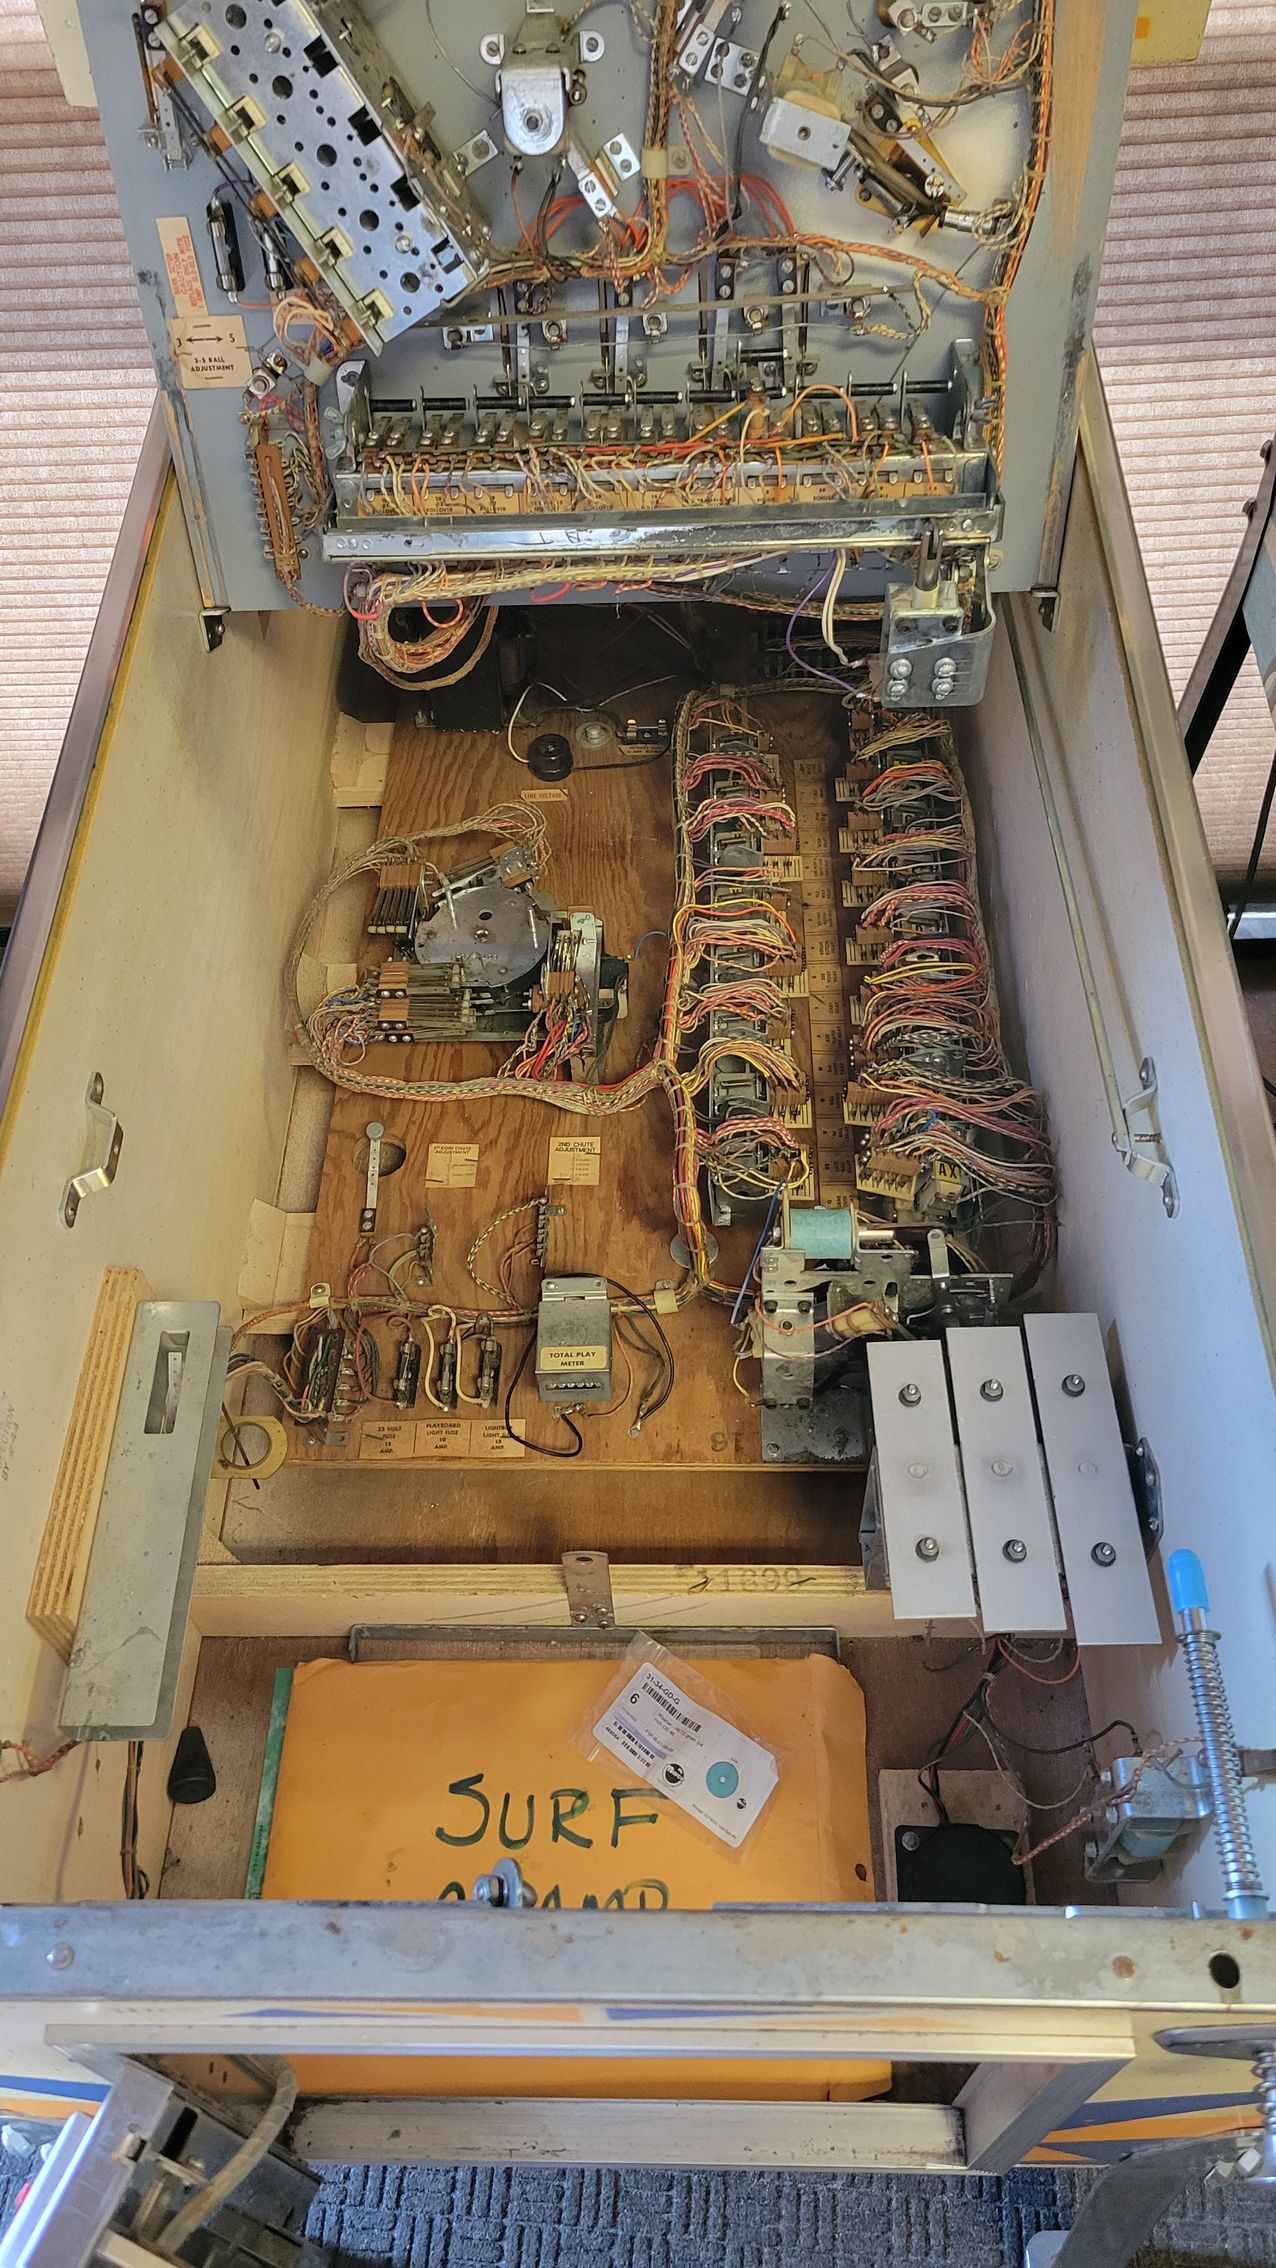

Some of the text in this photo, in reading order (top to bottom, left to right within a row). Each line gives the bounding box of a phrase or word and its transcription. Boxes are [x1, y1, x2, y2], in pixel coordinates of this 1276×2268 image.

[174, 253, 187, 295] CAUTION
[176, 333, 235, 348] 3 5
[208, 356, 225, 364] BALL
[190, 364, 235, 373] ADJUSTMENT
[939, 1163, 957, 1179] AX
[646, 1673, 681, 1705] 31-34-GD-G
[630, 1693, 640, 1704] 6
[435, 1773, 669, 1850] SURF
